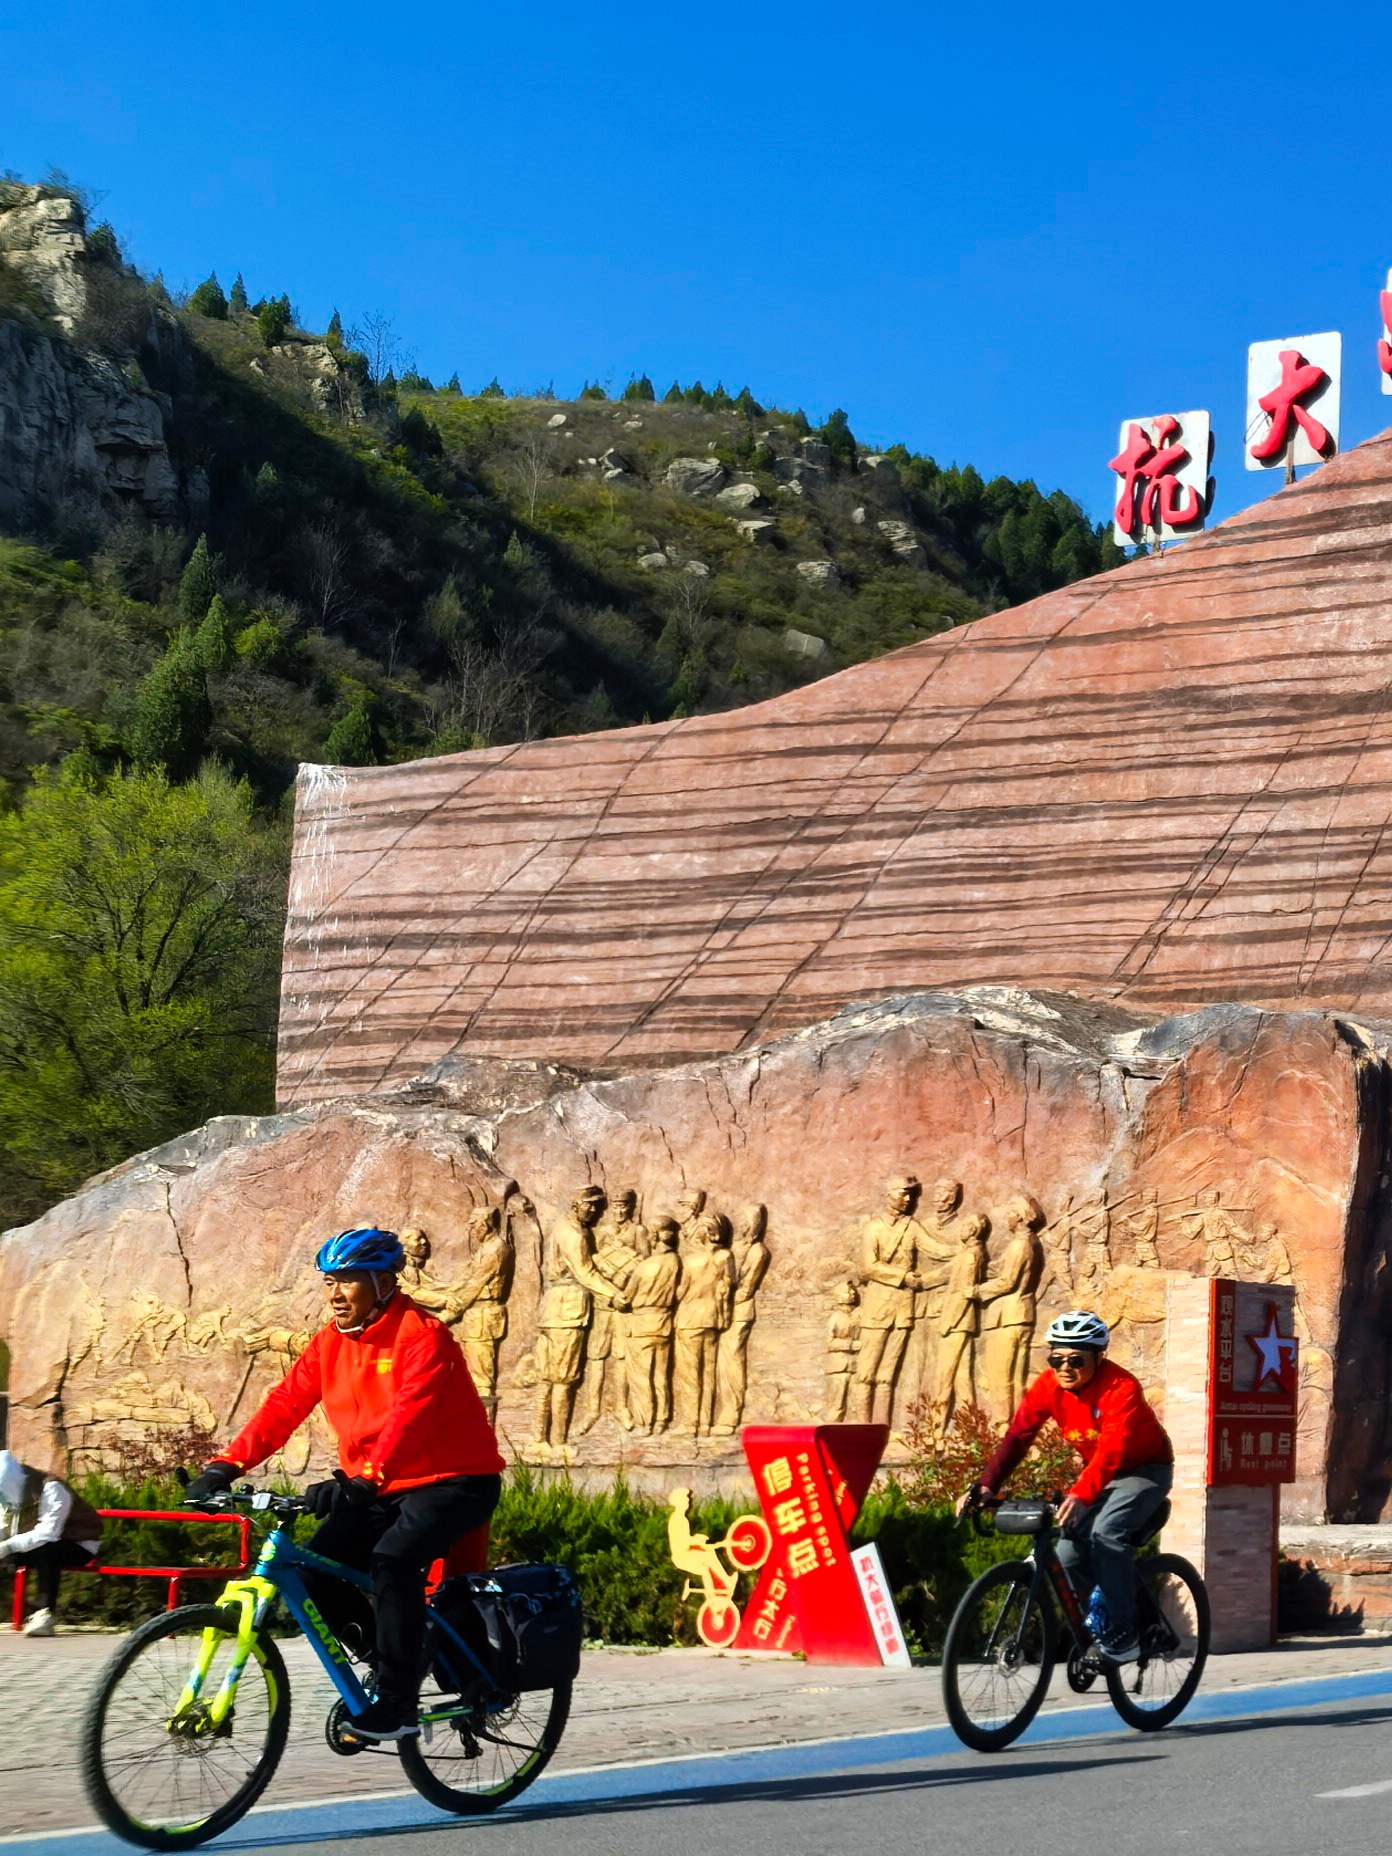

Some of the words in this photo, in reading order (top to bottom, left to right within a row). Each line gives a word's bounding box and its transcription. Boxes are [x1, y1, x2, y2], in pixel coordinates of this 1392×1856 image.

[762, 1455, 819, 1579] 停车点
[796, 1452, 823, 1525] Parking
[303, 1598, 347, 1664] GIANT
